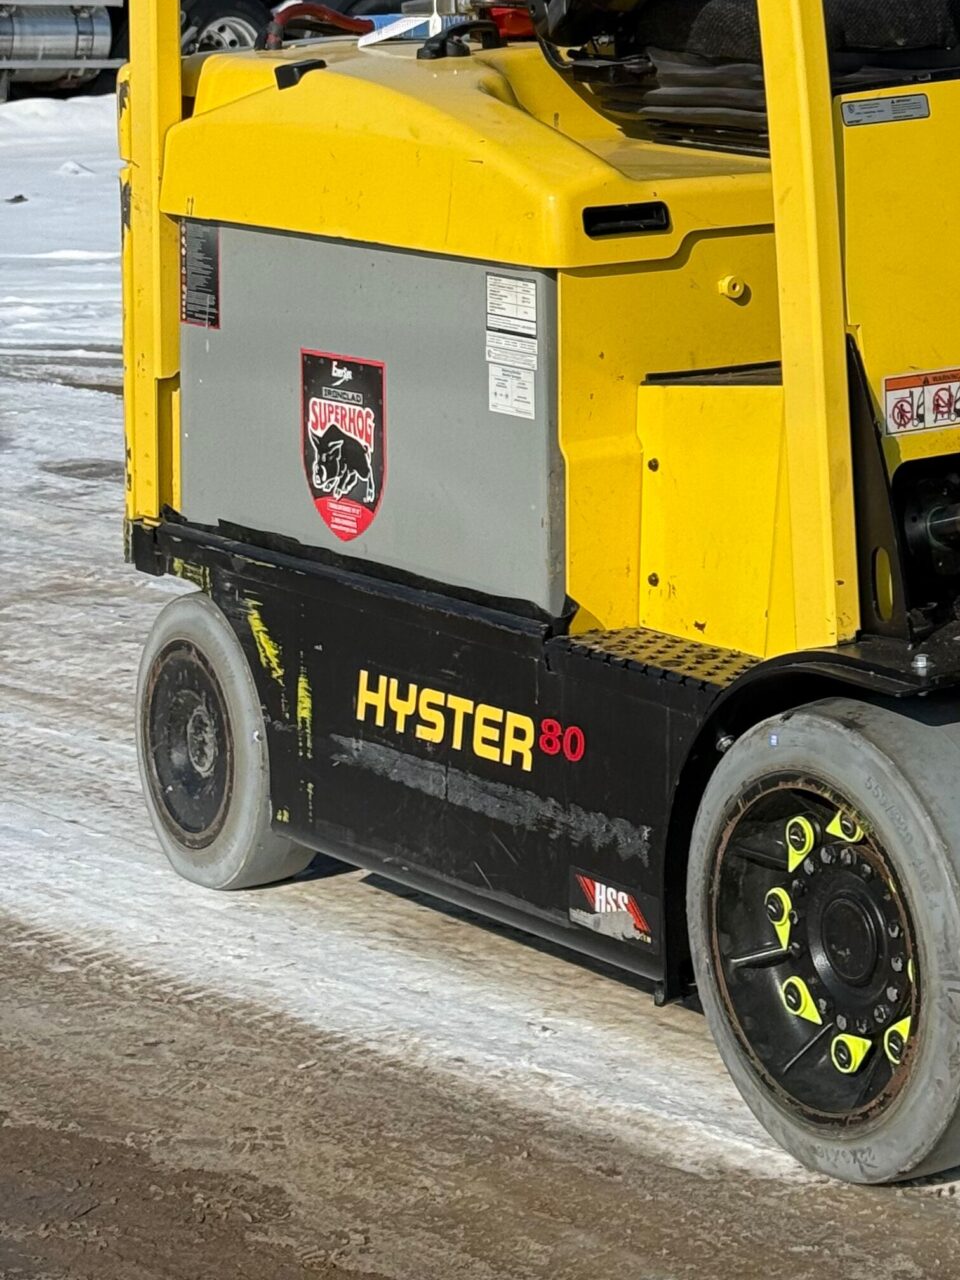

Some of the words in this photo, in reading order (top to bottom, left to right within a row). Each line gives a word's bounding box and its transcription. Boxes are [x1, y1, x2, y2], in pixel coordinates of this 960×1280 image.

[324, 388, 362, 403] IRONCLAD
[310, 399, 374, 444] SUPERHOG
[356, 669, 535, 772] HYSTER
[539, 718, 585, 762] 80
[595, 881, 629, 913] HSS
